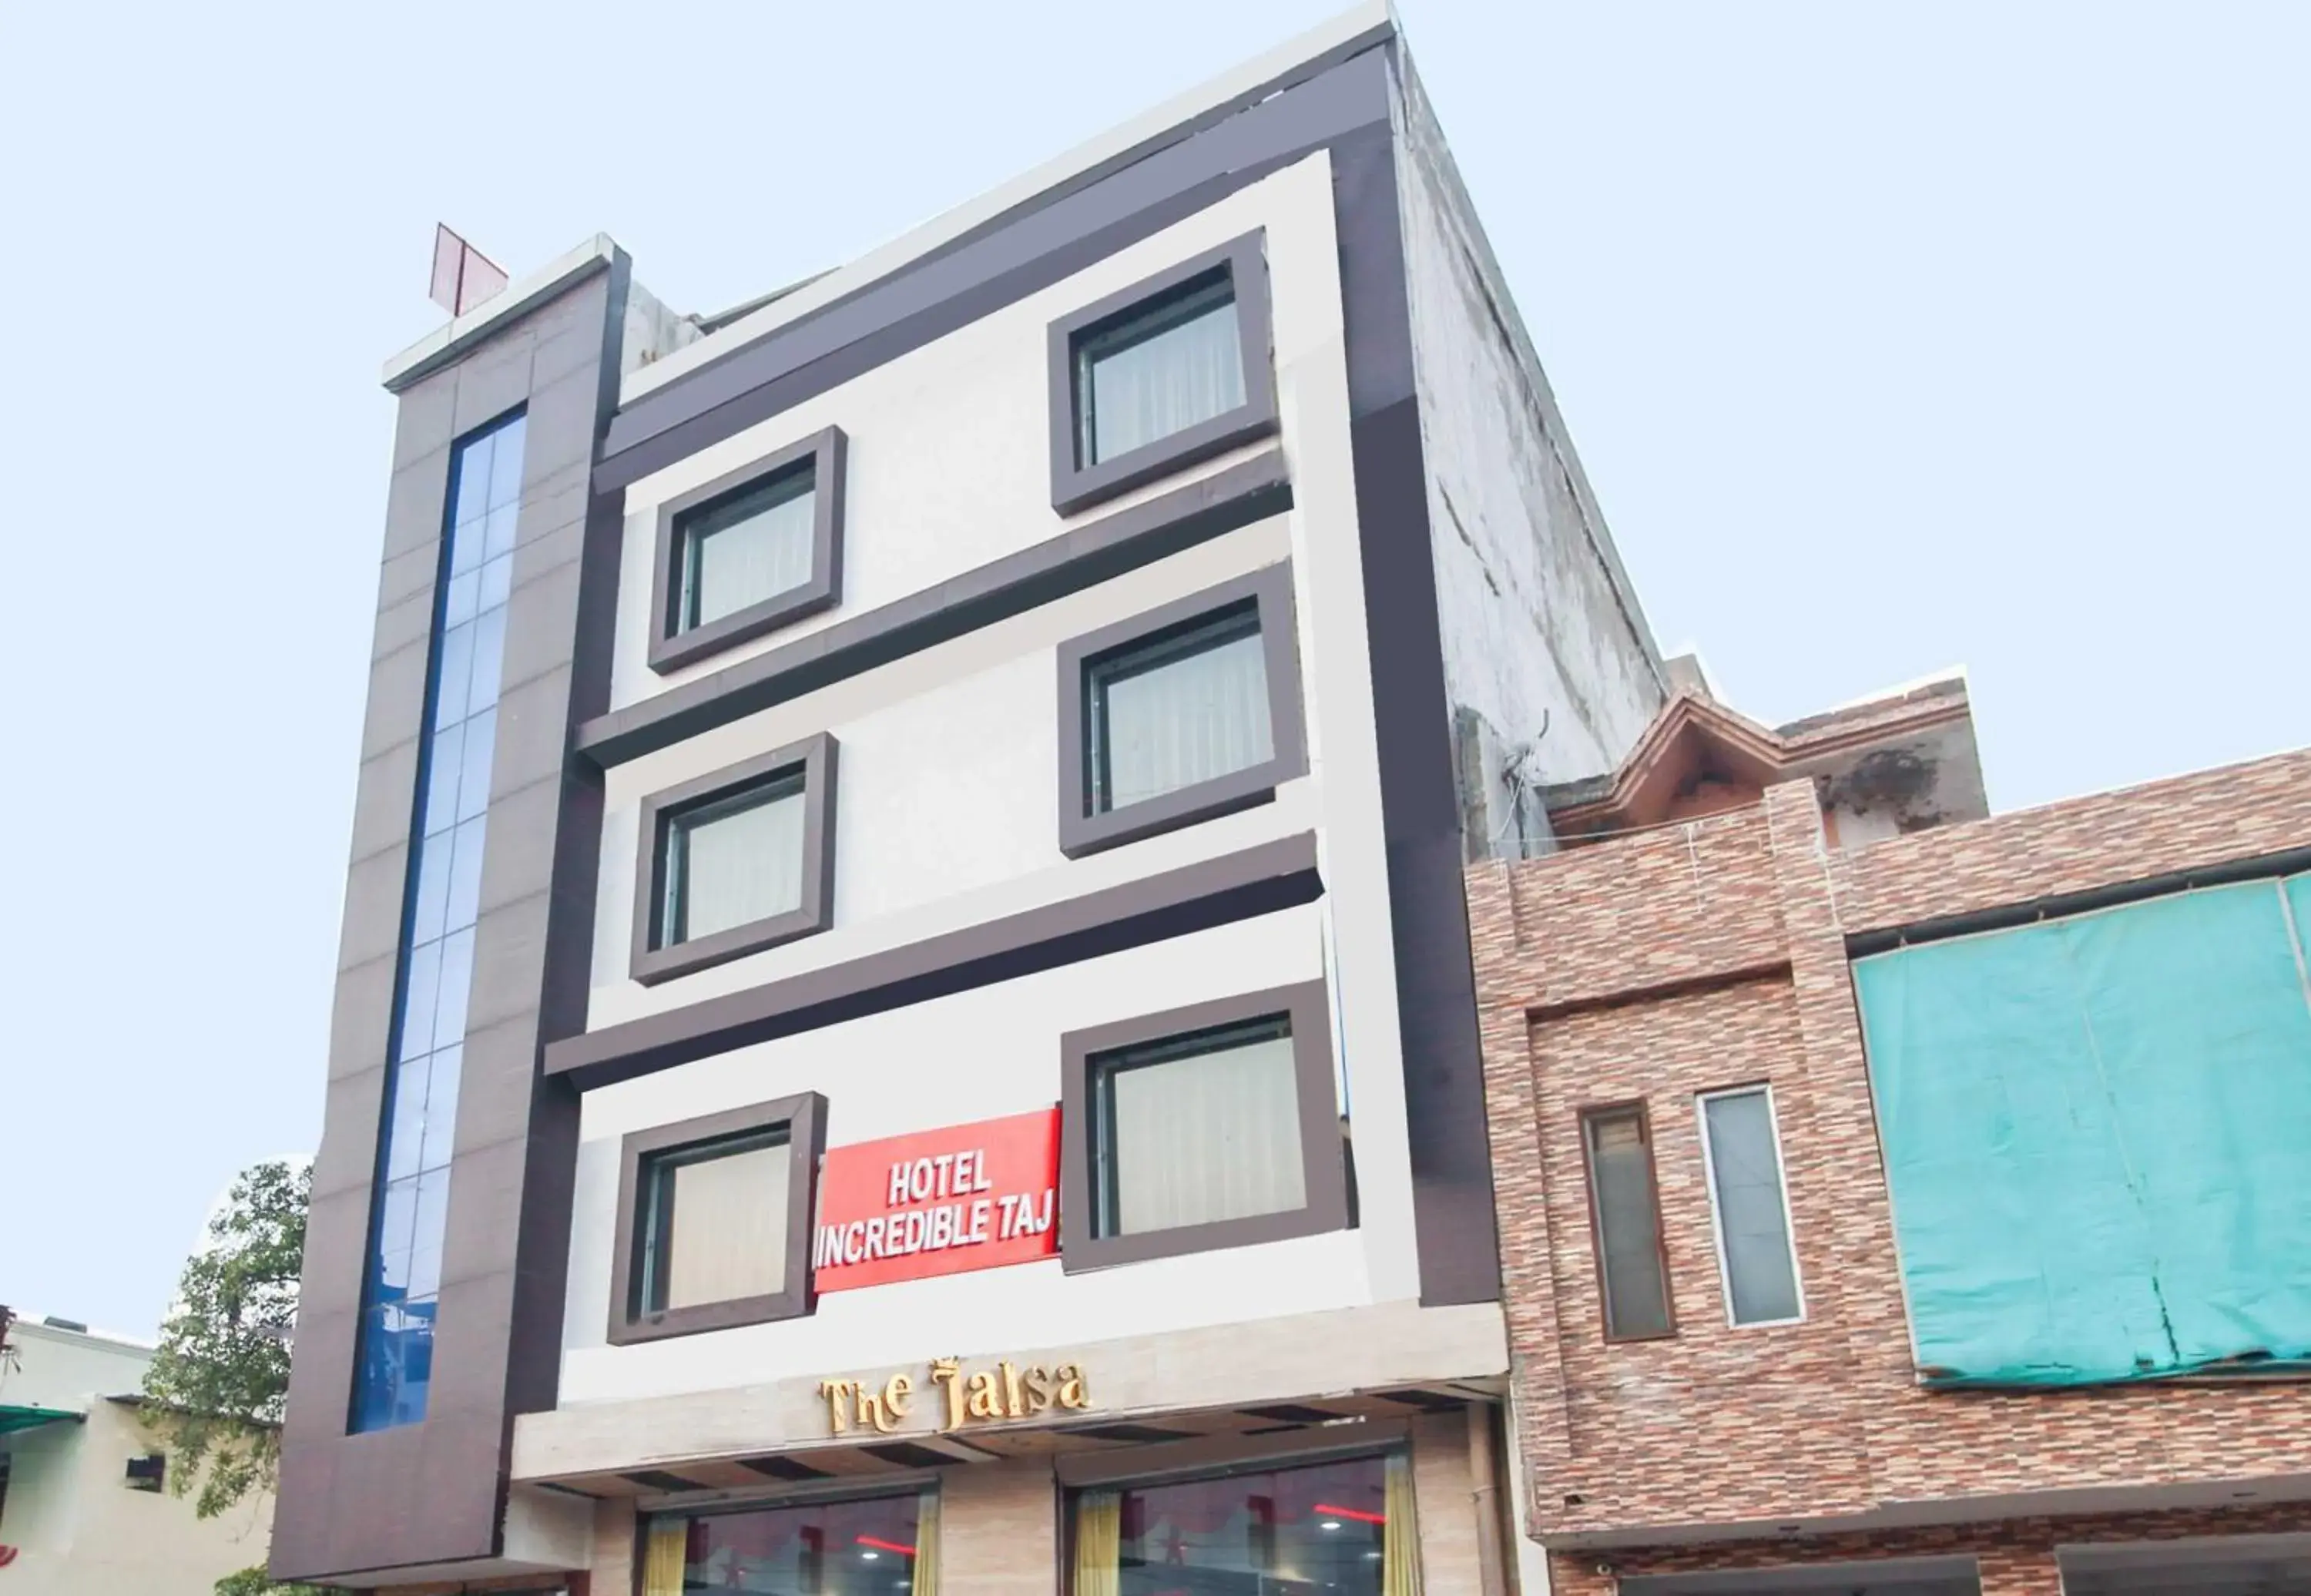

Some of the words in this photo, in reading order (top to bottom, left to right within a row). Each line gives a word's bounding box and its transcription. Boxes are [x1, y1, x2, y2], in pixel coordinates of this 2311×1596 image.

[889, 1149, 992, 1206] HOTEL
[814, 1199, 990, 1269] INCREDIBLE
[998, 1189, 1055, 1239] TAJ
[820, 1373, 913, 1433] The
[930, 1356, 1092, 1433] Jalsa
